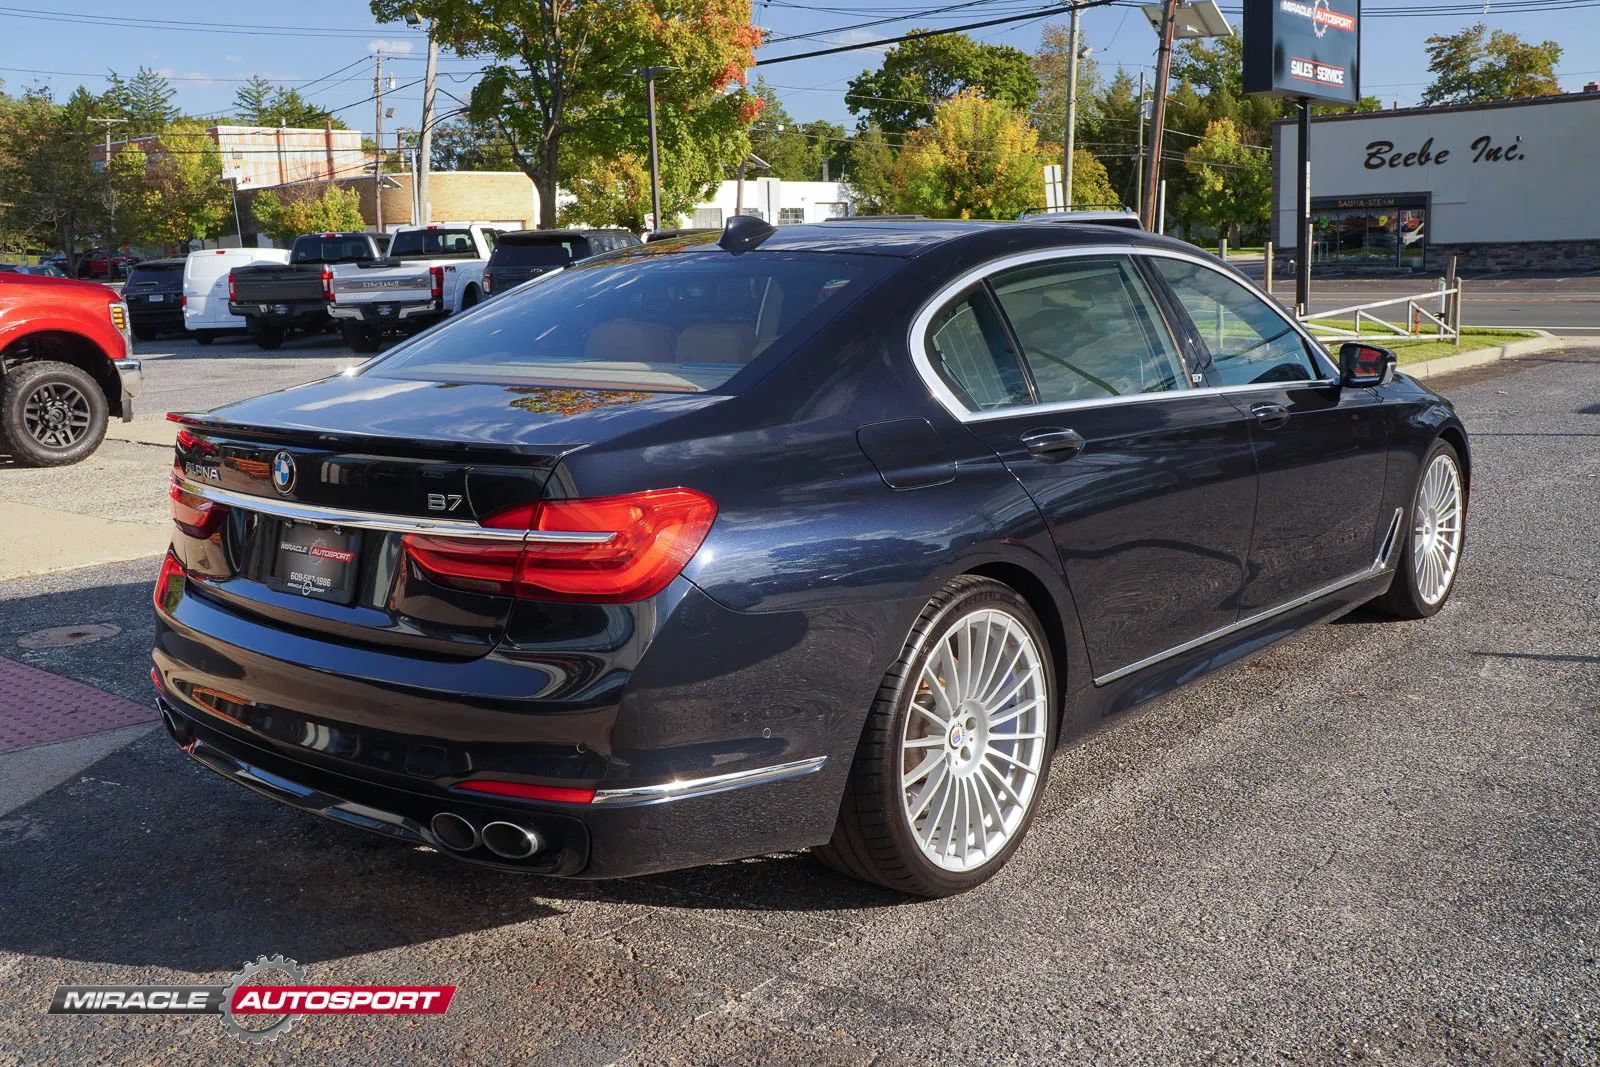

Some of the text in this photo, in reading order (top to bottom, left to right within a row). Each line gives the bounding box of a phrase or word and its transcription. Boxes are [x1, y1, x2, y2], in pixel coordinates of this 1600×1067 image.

[1282, 1, 1353, 29] MIRACLE AUTOSPORT
[1291, 60, 1344, 84] SALES SERVICE
[1364, 135, 1524, 170] Beebe Inc.
[185, 461, 222, 481] ALPINA
[428, 493, 462, 511] B7
[281, 541, 351, 561] MIRACLE AUTOSPORT
